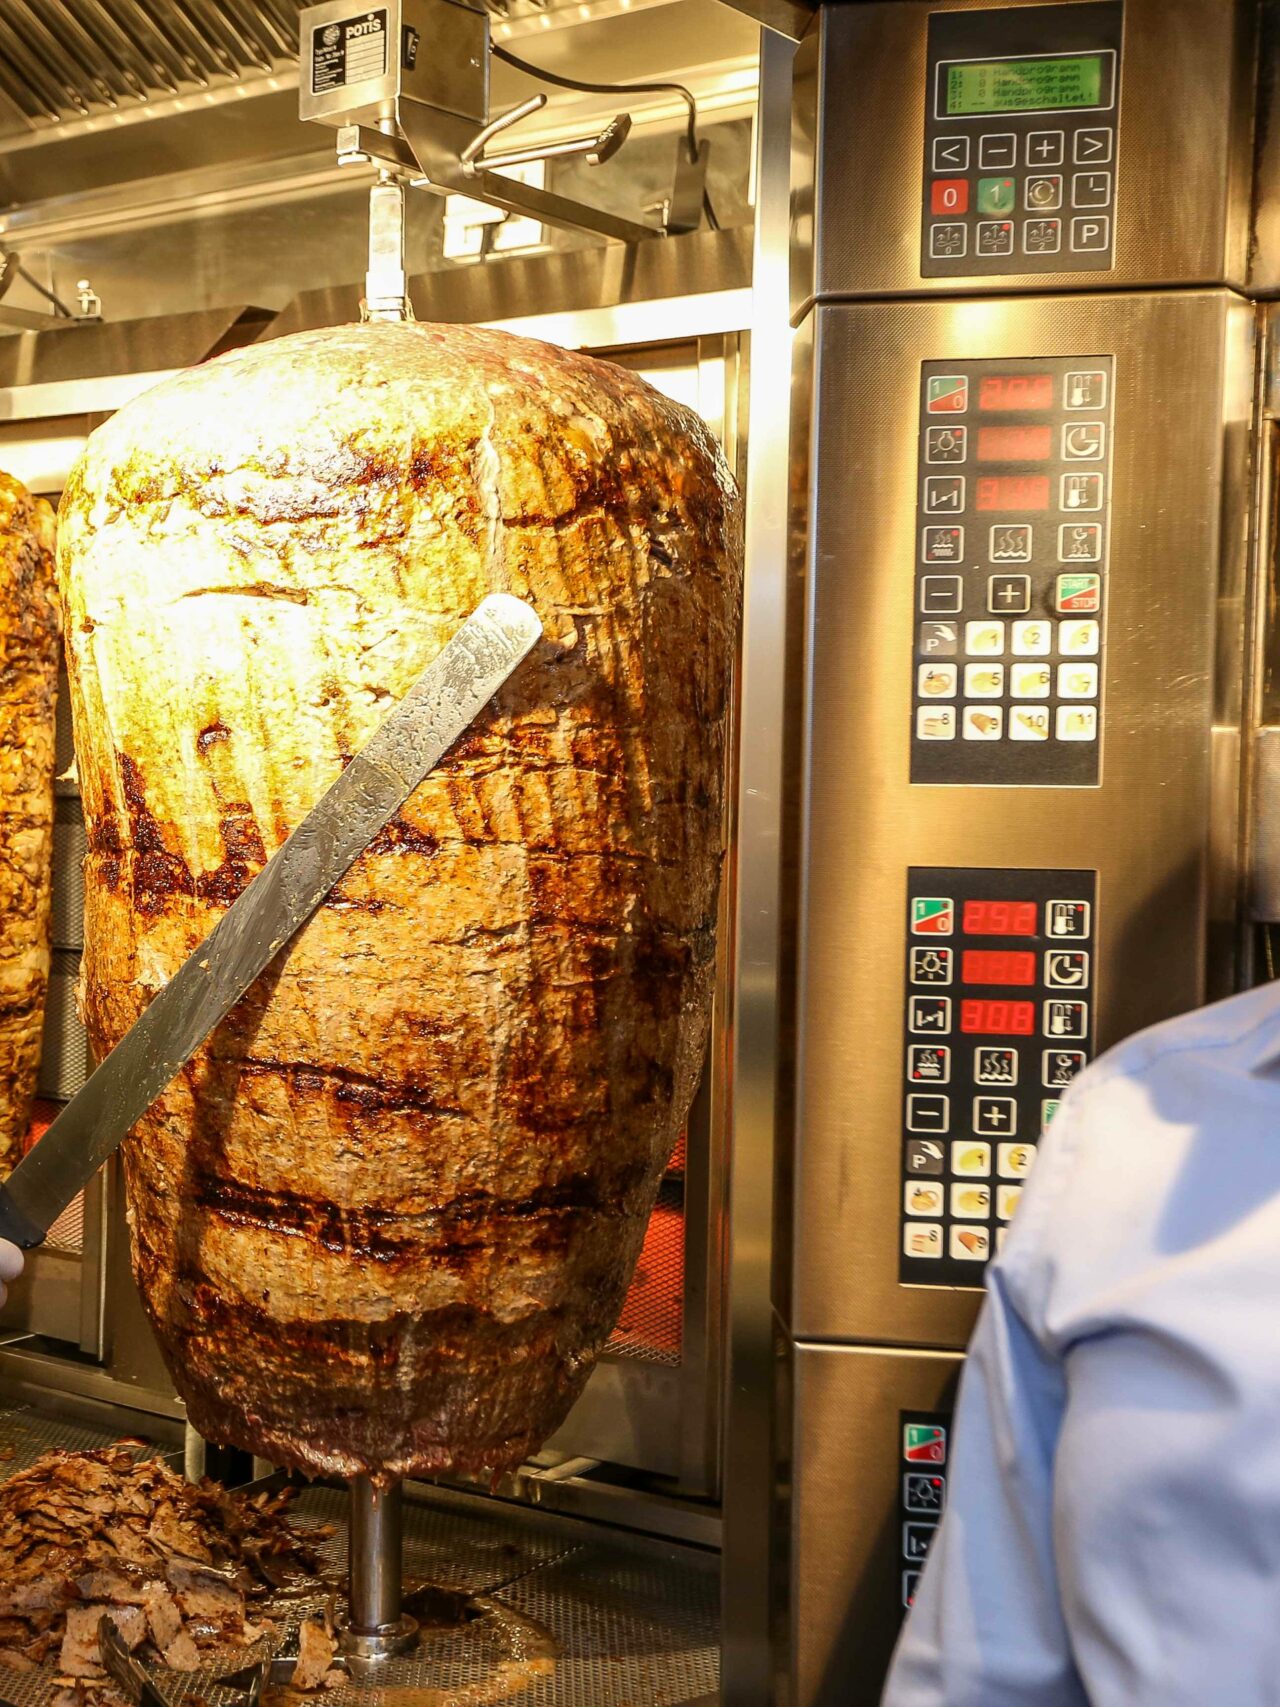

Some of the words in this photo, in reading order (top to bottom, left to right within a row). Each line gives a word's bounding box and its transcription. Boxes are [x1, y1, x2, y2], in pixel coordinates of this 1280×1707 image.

[943, 188, 958, 208] 0
[990, 186, 1000, 203] 1
[1081, 224, 1100, 244] P
[926, 639, 939, 652] P
[1031, 632, 1041, 645] 2
[1080, 632, 1090, 645] 3
[991, 672, 1001, 686] 5
[1039, 671, 1051, 684] 6
[941, 713, 950, 726] 8
[917, 902, 926, 916] 1
[936, 918, 950, 932] 0
[912, 1154, 927, 1169] P
[1017, 1153, 1027, 1167] 2
